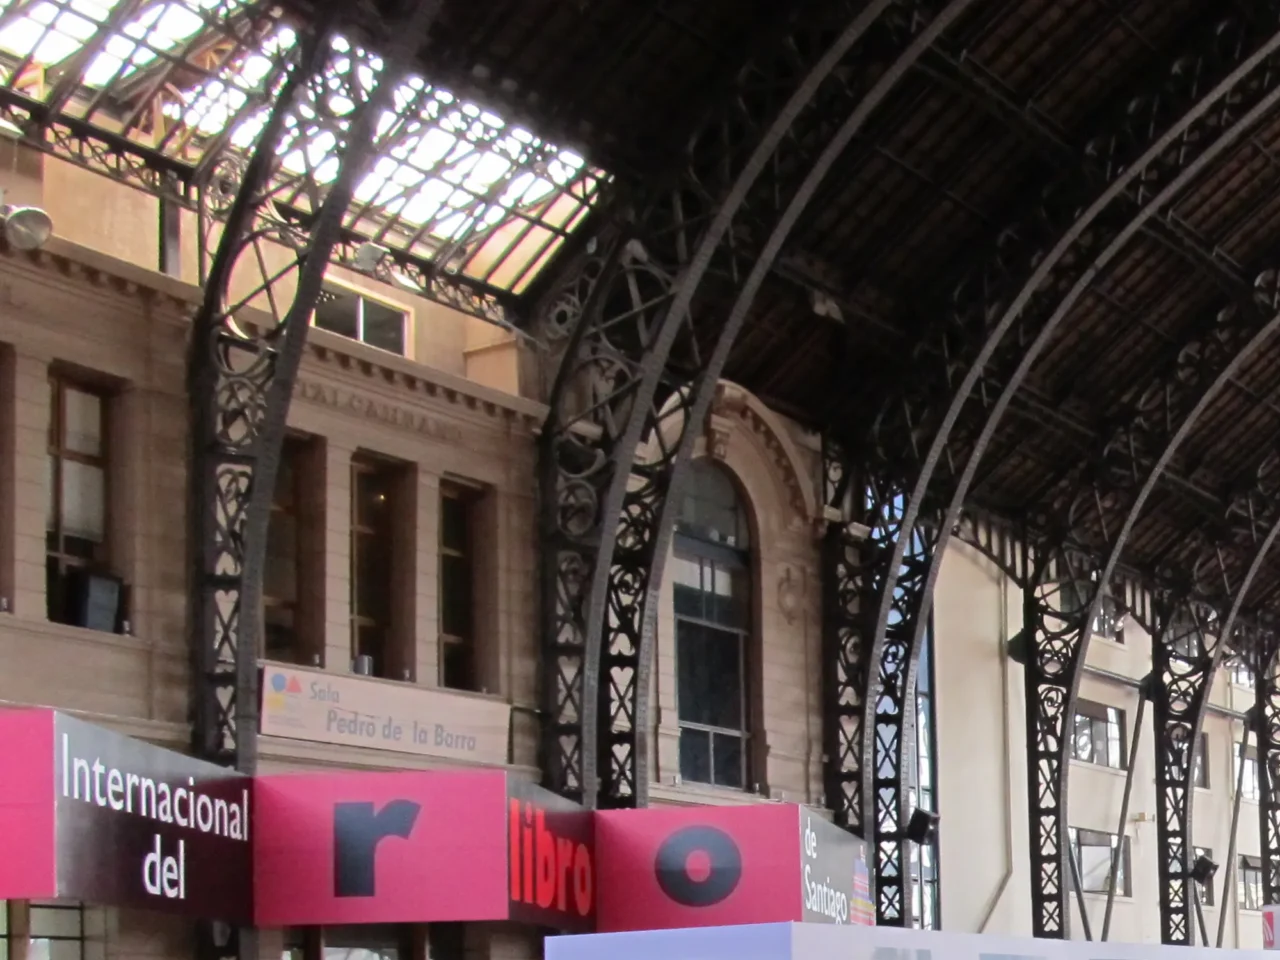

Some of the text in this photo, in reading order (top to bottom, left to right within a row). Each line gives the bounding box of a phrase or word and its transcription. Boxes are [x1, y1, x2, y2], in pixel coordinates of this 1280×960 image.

[309, 682, 340, 703] Sala
[326, 709, 376, 737] Pedro
[382, 718, 402, 741] de
[413, 721, 428, 745] la
[434, 724, 476, 751] Barra
[62, 733, 248, 841] Internacional
[143, 834, 185, 899] del
[333, 799, 421, 897] r
[509, 797, 592, 916] libro
[805, 817, 817, 859] de
[805, 865, 848, 924] Santiago
